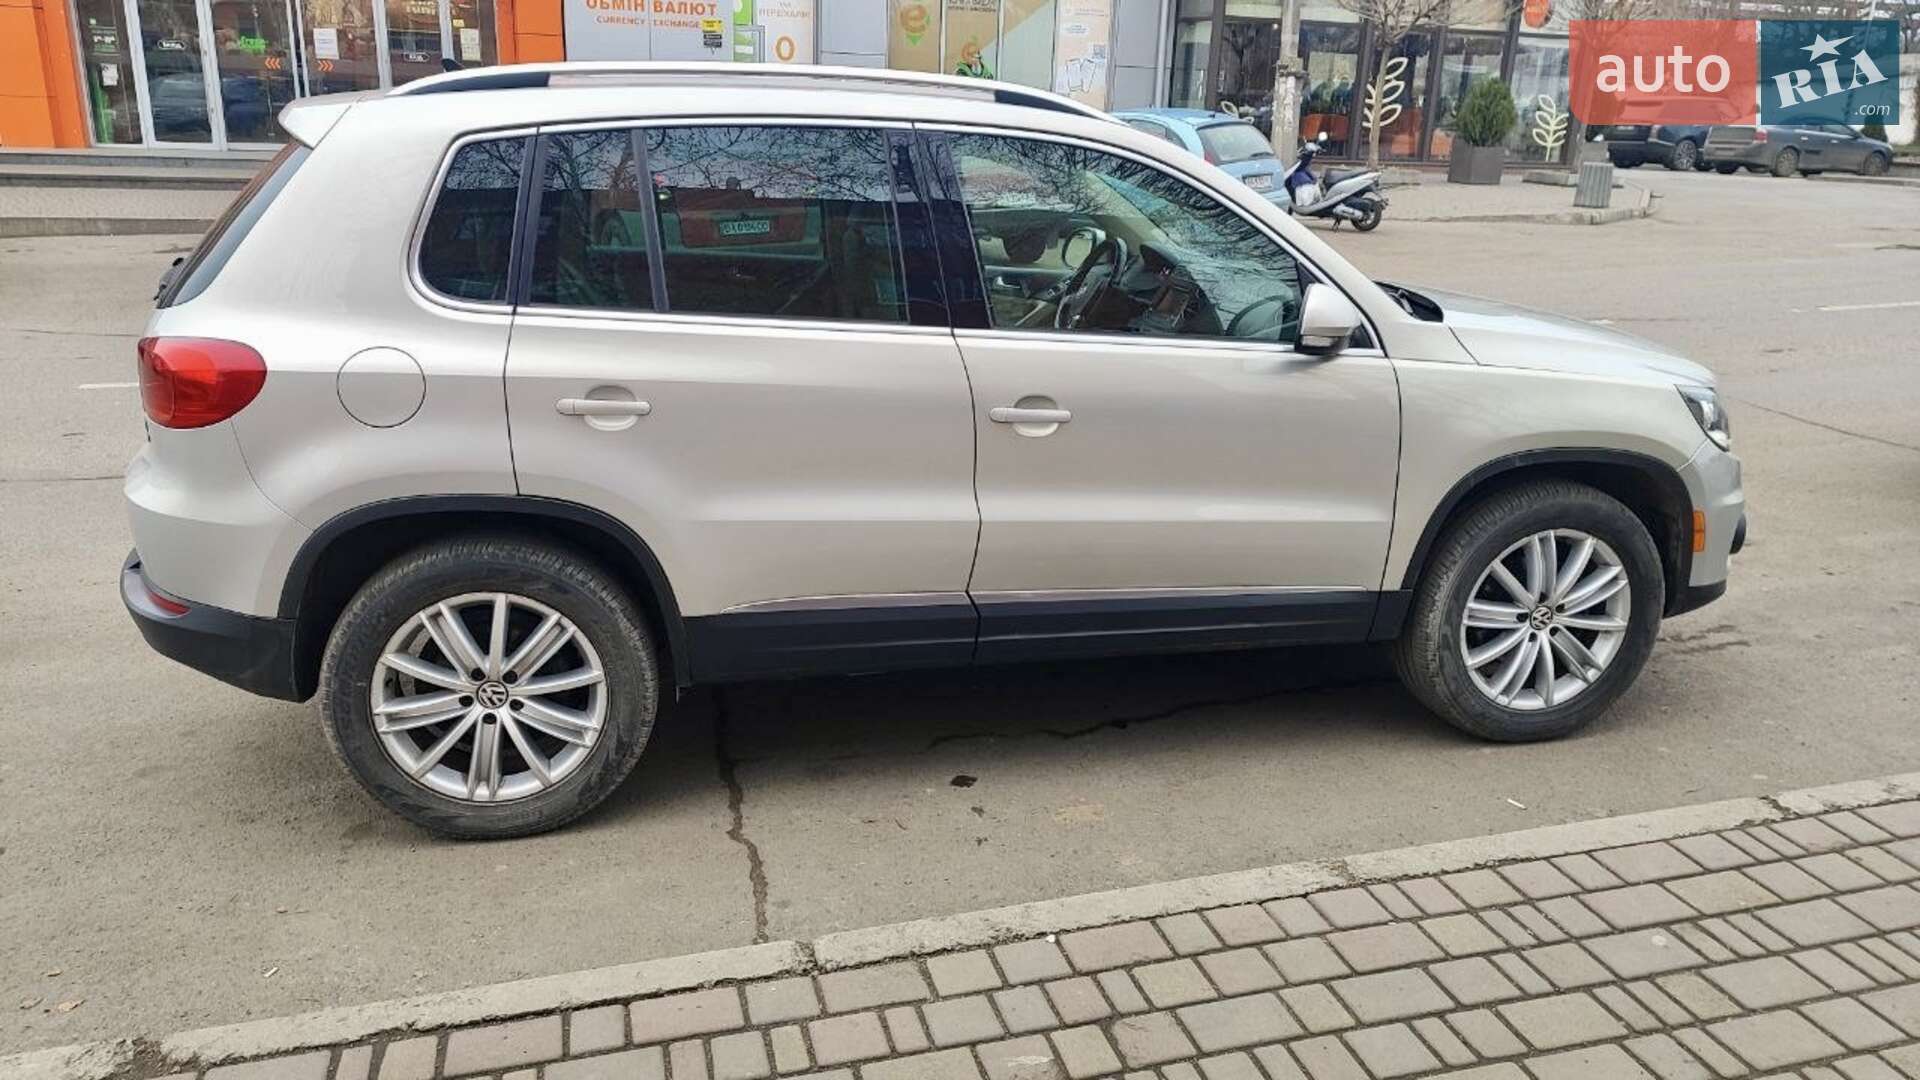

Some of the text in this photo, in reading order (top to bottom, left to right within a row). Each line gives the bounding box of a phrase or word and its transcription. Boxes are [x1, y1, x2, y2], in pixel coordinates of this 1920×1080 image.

[586, 0, 717, 16] ОБМІН ВАЛЮТ
[596, 15, 701, 29] CURRENCY EXCHANGE
